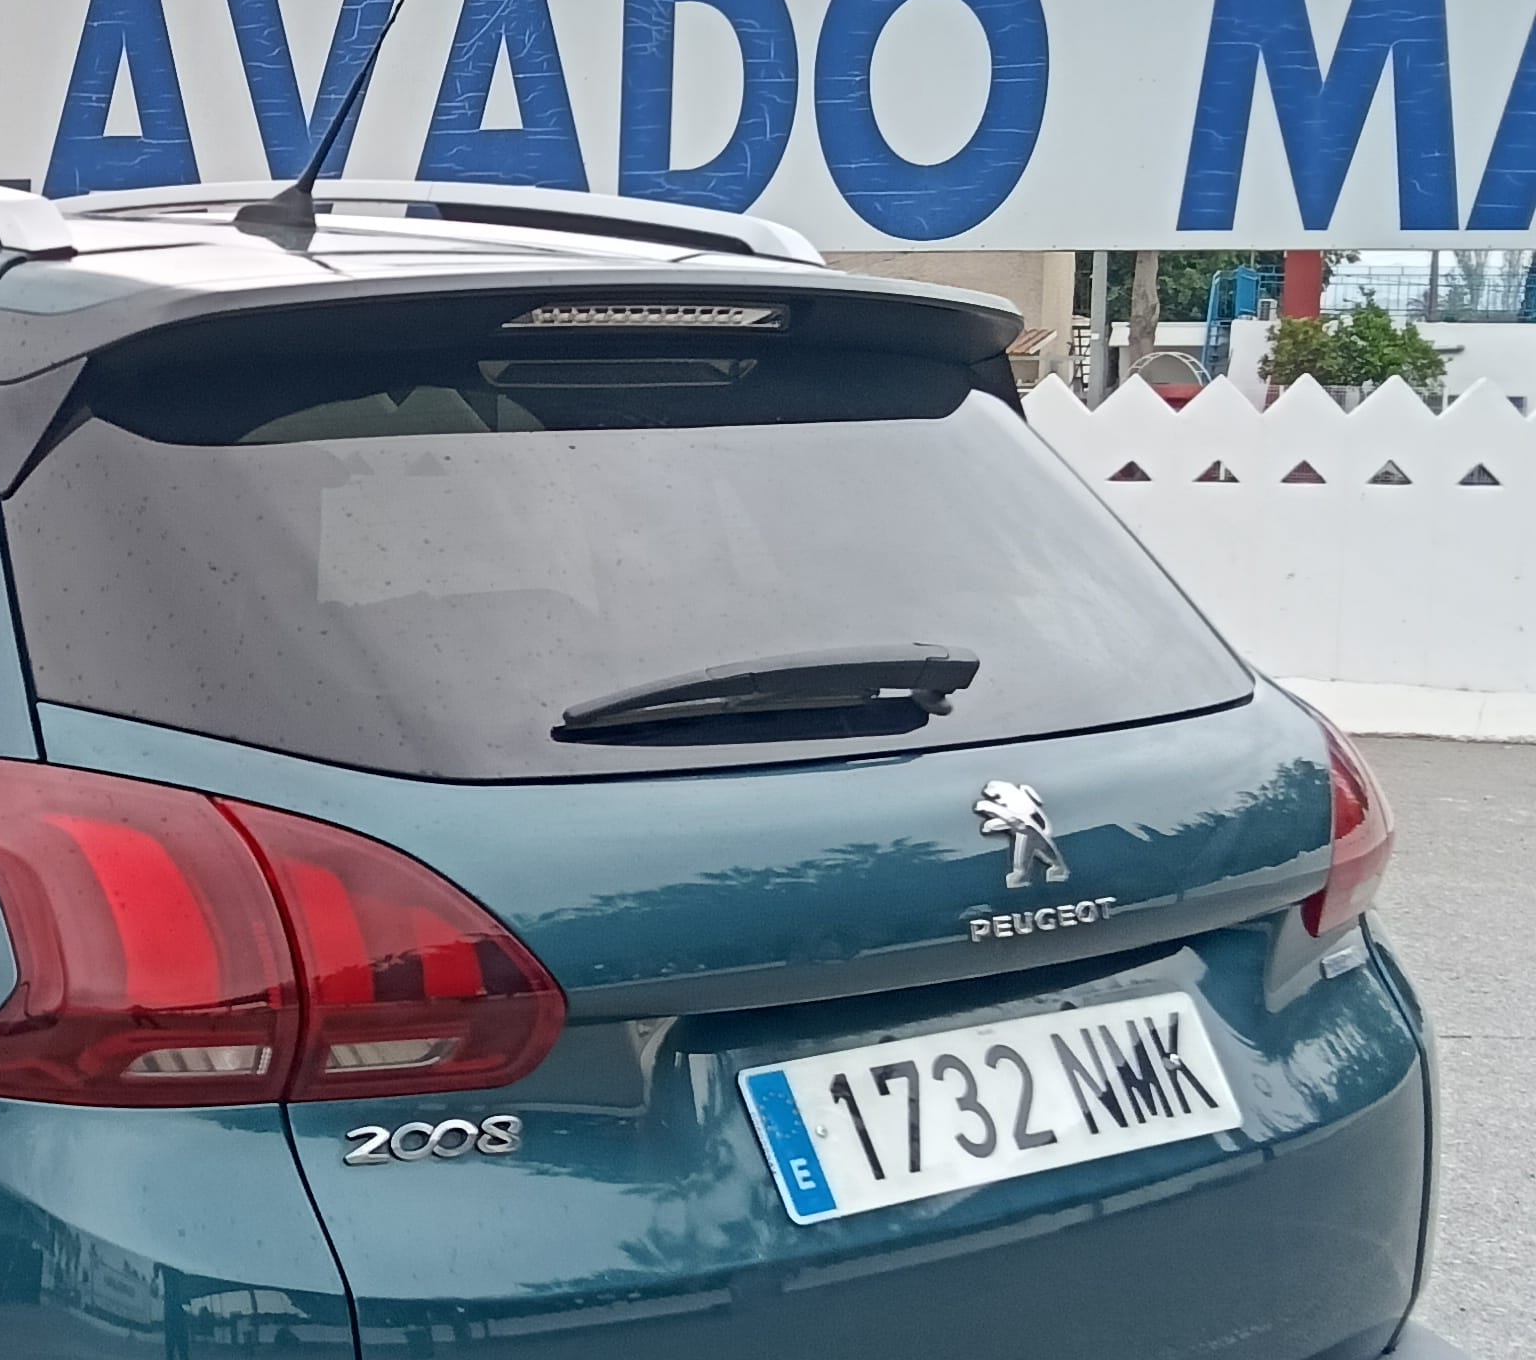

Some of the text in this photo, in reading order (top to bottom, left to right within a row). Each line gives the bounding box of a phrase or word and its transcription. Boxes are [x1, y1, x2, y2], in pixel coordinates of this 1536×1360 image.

[969, 896, 1118, 943] PEUGEOT
[830, 1043, 1058, 1181] 1732
[1050, 1011, 1220, 1135] NMK
[344, 1114, 523, 1167] 2008
[788, 1157, 817, 1192] E
